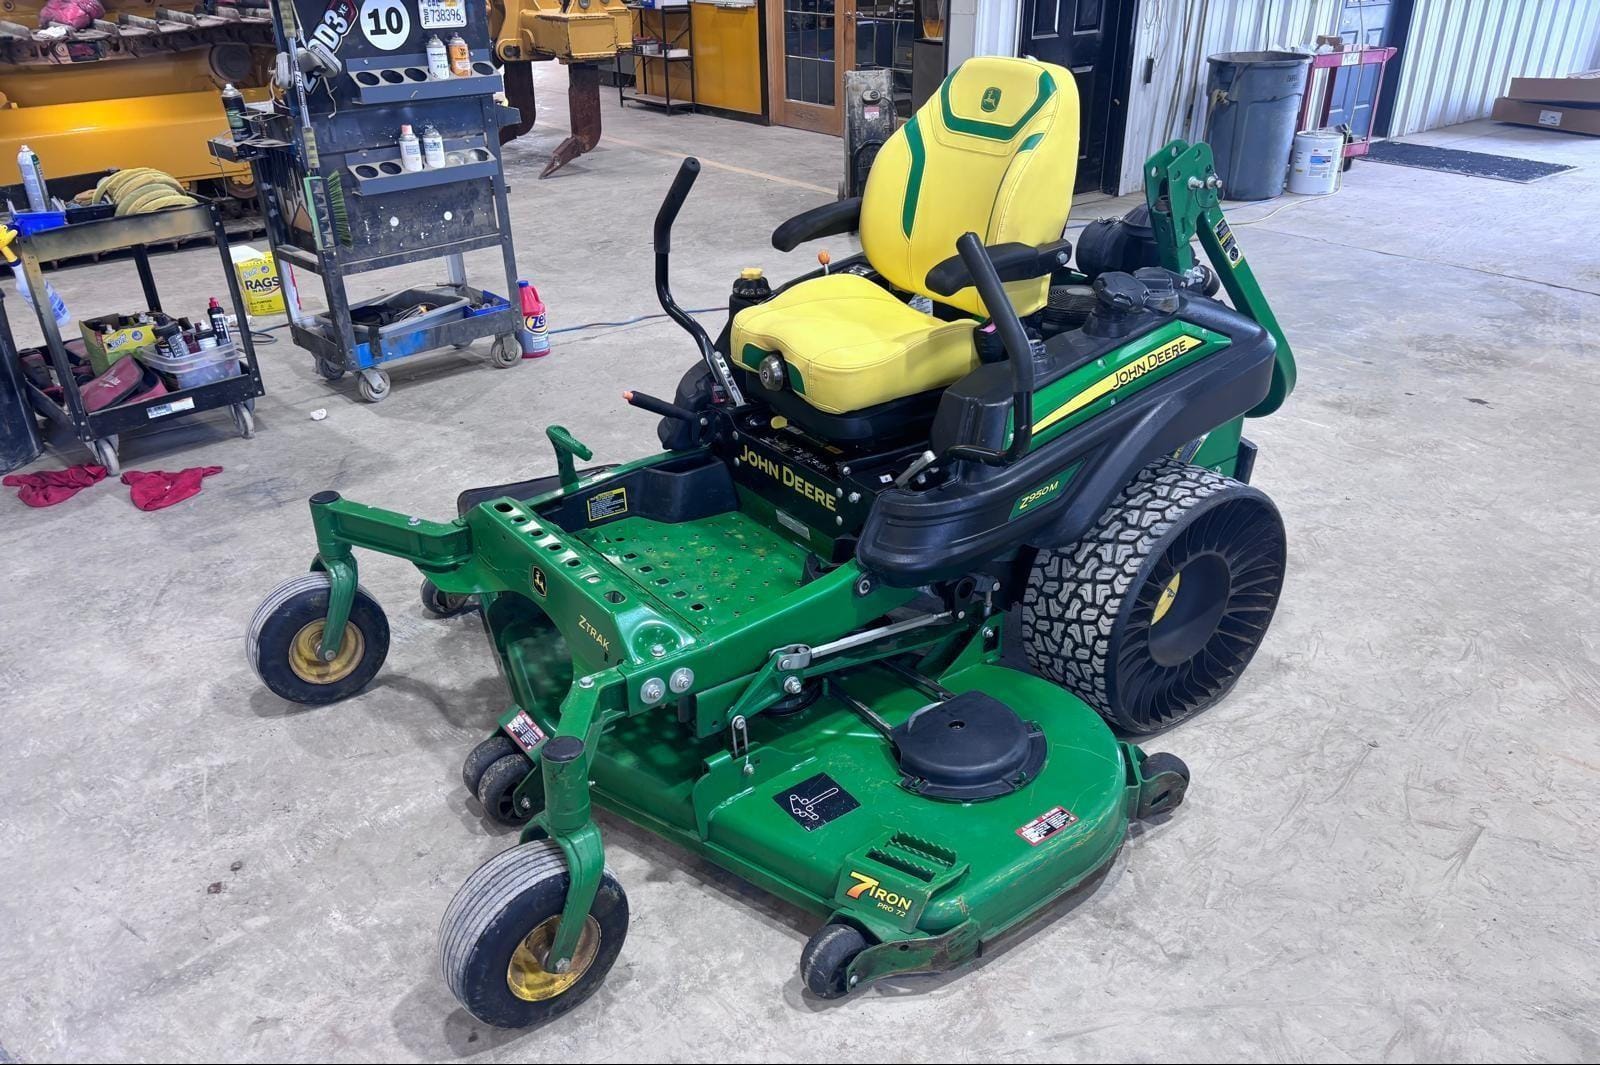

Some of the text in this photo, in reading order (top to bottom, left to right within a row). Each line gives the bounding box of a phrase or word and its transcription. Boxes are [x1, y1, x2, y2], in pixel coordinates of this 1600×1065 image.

[367, 6, 404, 36] 10
[430, 8, 462, 23] 738396
[245, 276, 281, 291] RAGS
[1112, 340, 1188, 389] JOHN DEERE
[739, 444, 780, 480] JOHN
[782, 465, 837, 512] DEERE
[1018, 480, 1059, 510] Z950M
[577, 614, 611, 651] ZTRAK
[876, 902, 906, 918] PRO 72
